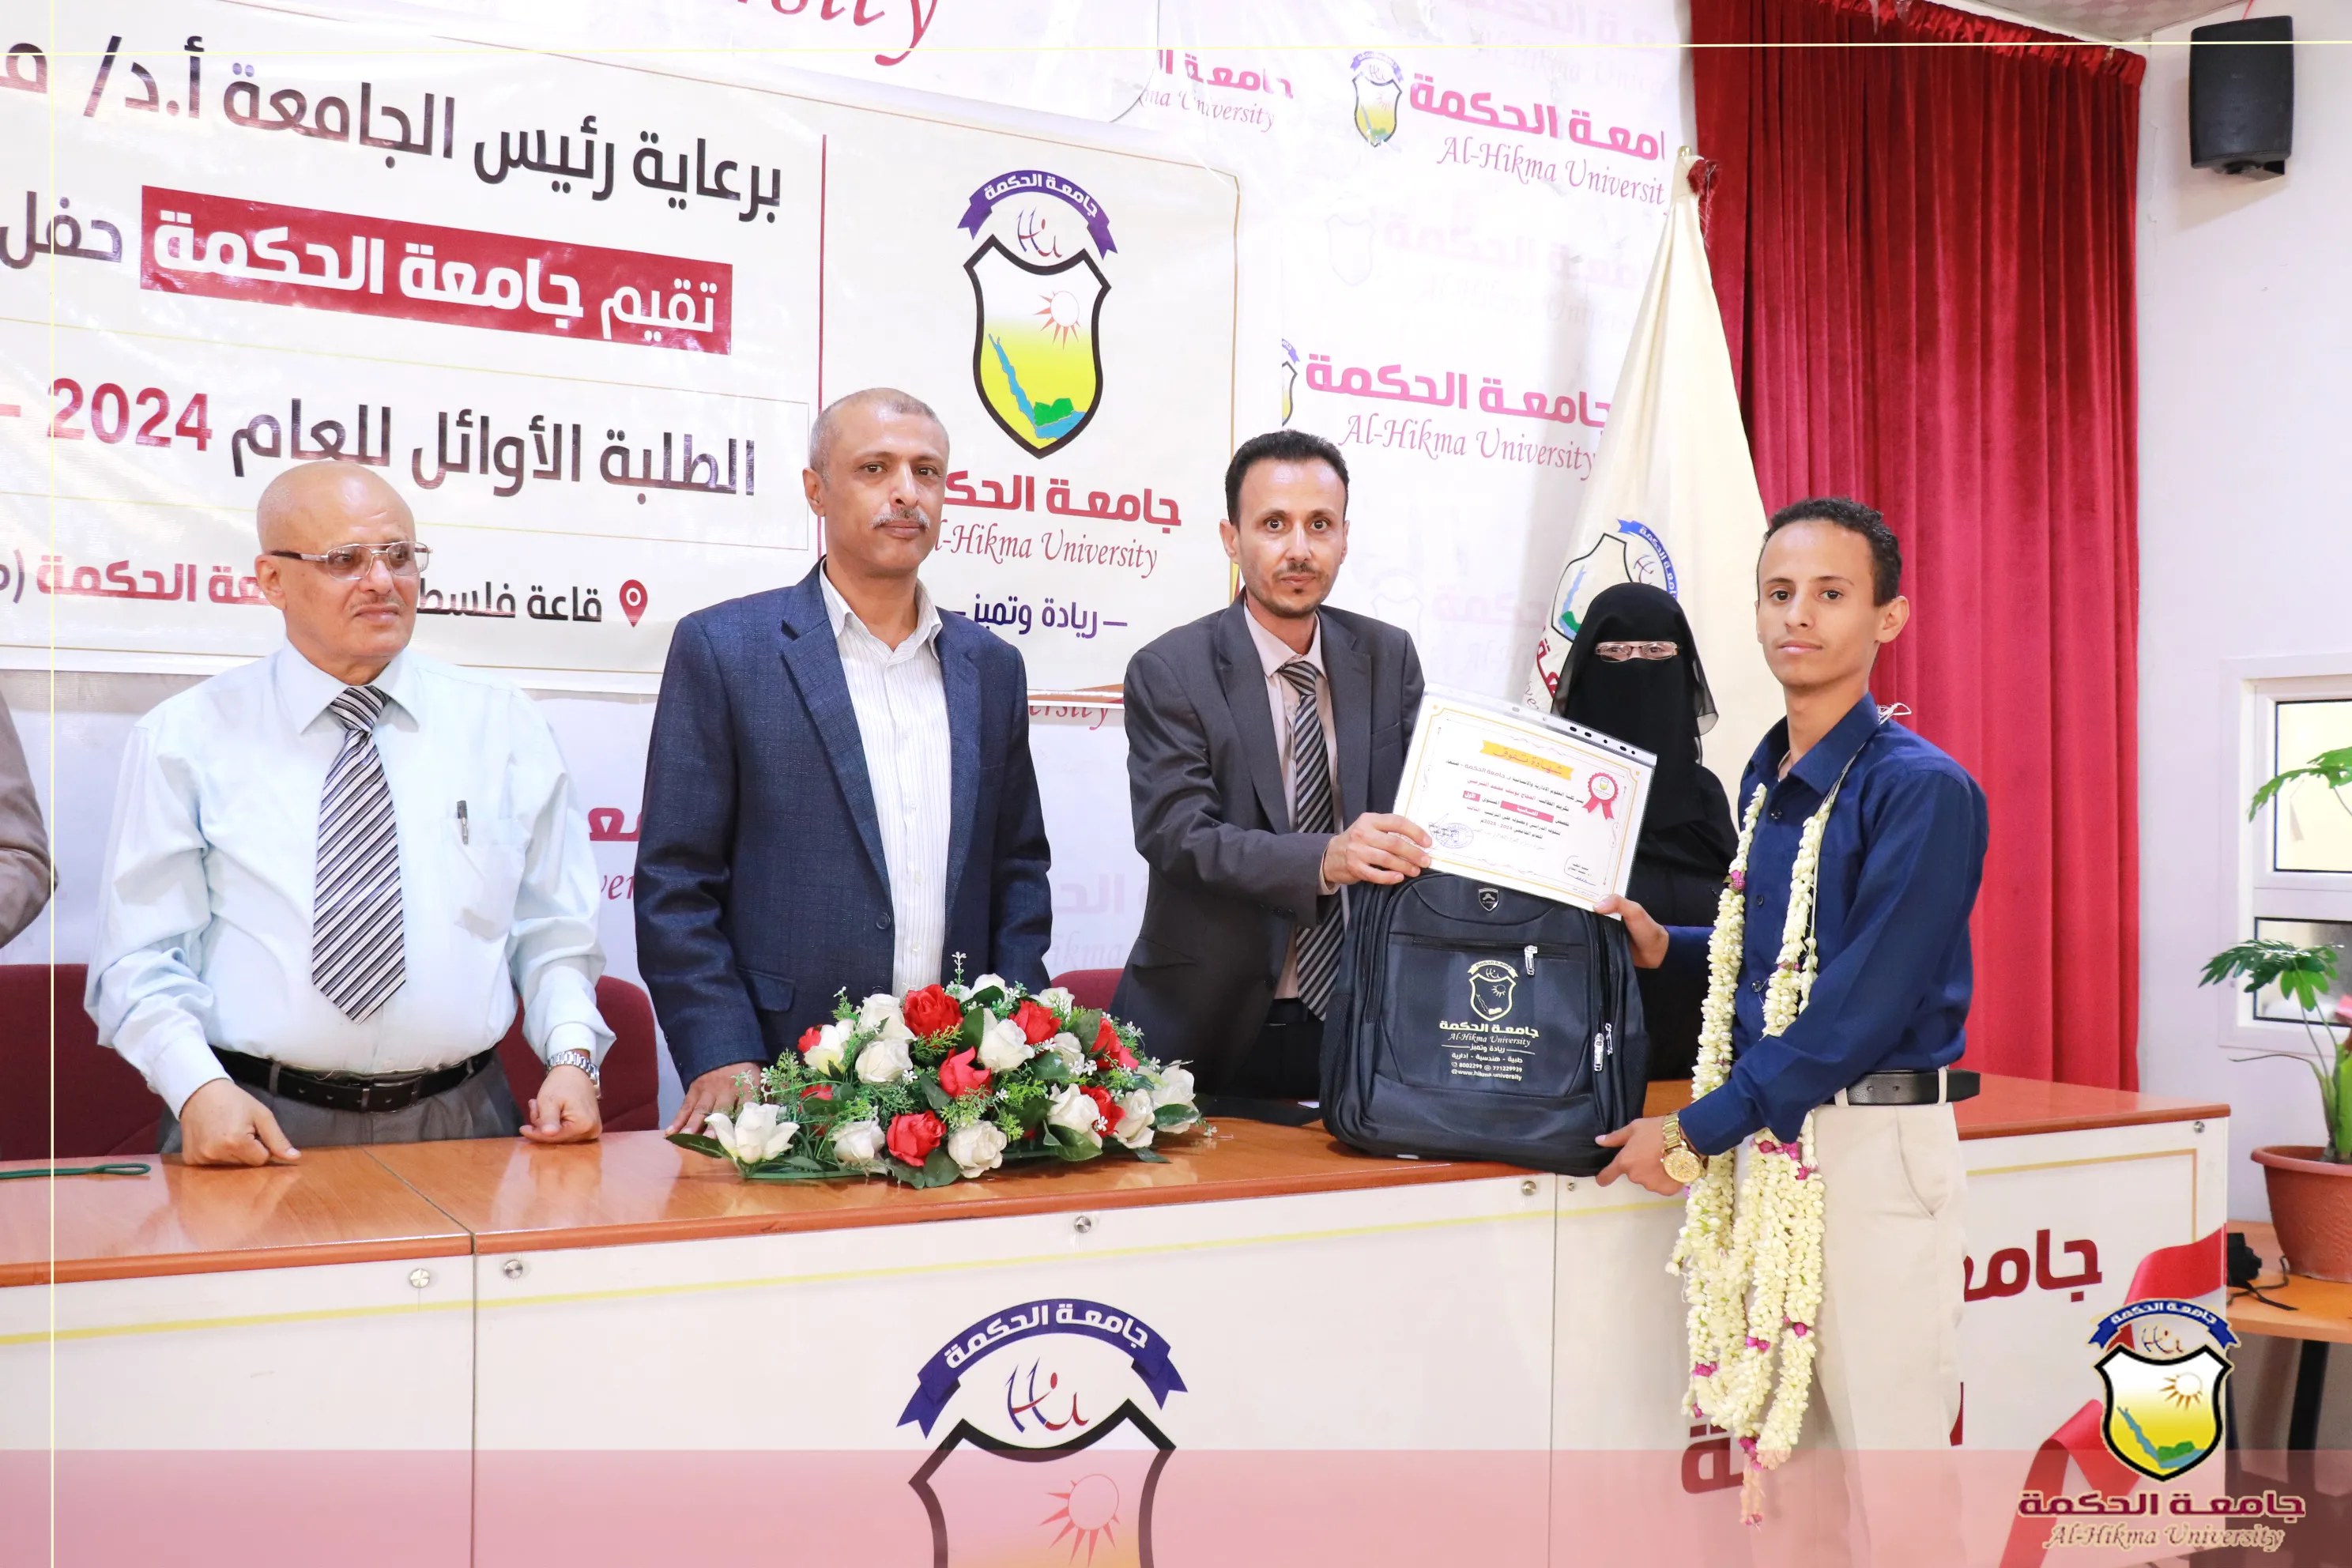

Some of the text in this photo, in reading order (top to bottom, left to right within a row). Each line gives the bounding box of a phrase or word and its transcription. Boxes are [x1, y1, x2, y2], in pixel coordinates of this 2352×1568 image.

[223, 62, 454, 168] الجامعة
[1410, 73, 1559, 139] الحكمة
[474, 115, 615, 202] رئيس
[632, 130, 781, 224] برعاية
[1436, 136, 1666, 206] Al-Hikma Universit
[984, 173, 1098, 217] جامعة الحكمة
[0, 191, 718, 344] تقيم جامعة الحكمة حفل
[47, 376, 213, 451] 2024
[1306, 353, 1468, 409] الحكمة
[232, 398, 392, 477] للعام
[412, 409, 582, 497] الأوائل
[599, 427, 756, 505] الطلبة
[1338, 413, 1596, 481] Al-Hikma University
[942, 470, 1182, 534] جامعة الحك
[36, 554, 197, 602] الحكمة
[934, 518, 1158, 579] l-Hikma University
[416, 577, 602, 622] قاعة فلسط
[974, 593, 1099, 639] ريادة وتميز
[1439, 1020, 1540, 1038] جامعة الحكمة
[1448, 1032, 1531, 1047] Al-Hikma University
[1470, 1043, 1506, 1054] ريادة وتميز
[1476, 1054, 1501, 1062] هندسية
[1963, 1229, 2102, 1302] جام
[944, 1304, 1149, 1369] جامعة الحكمة
